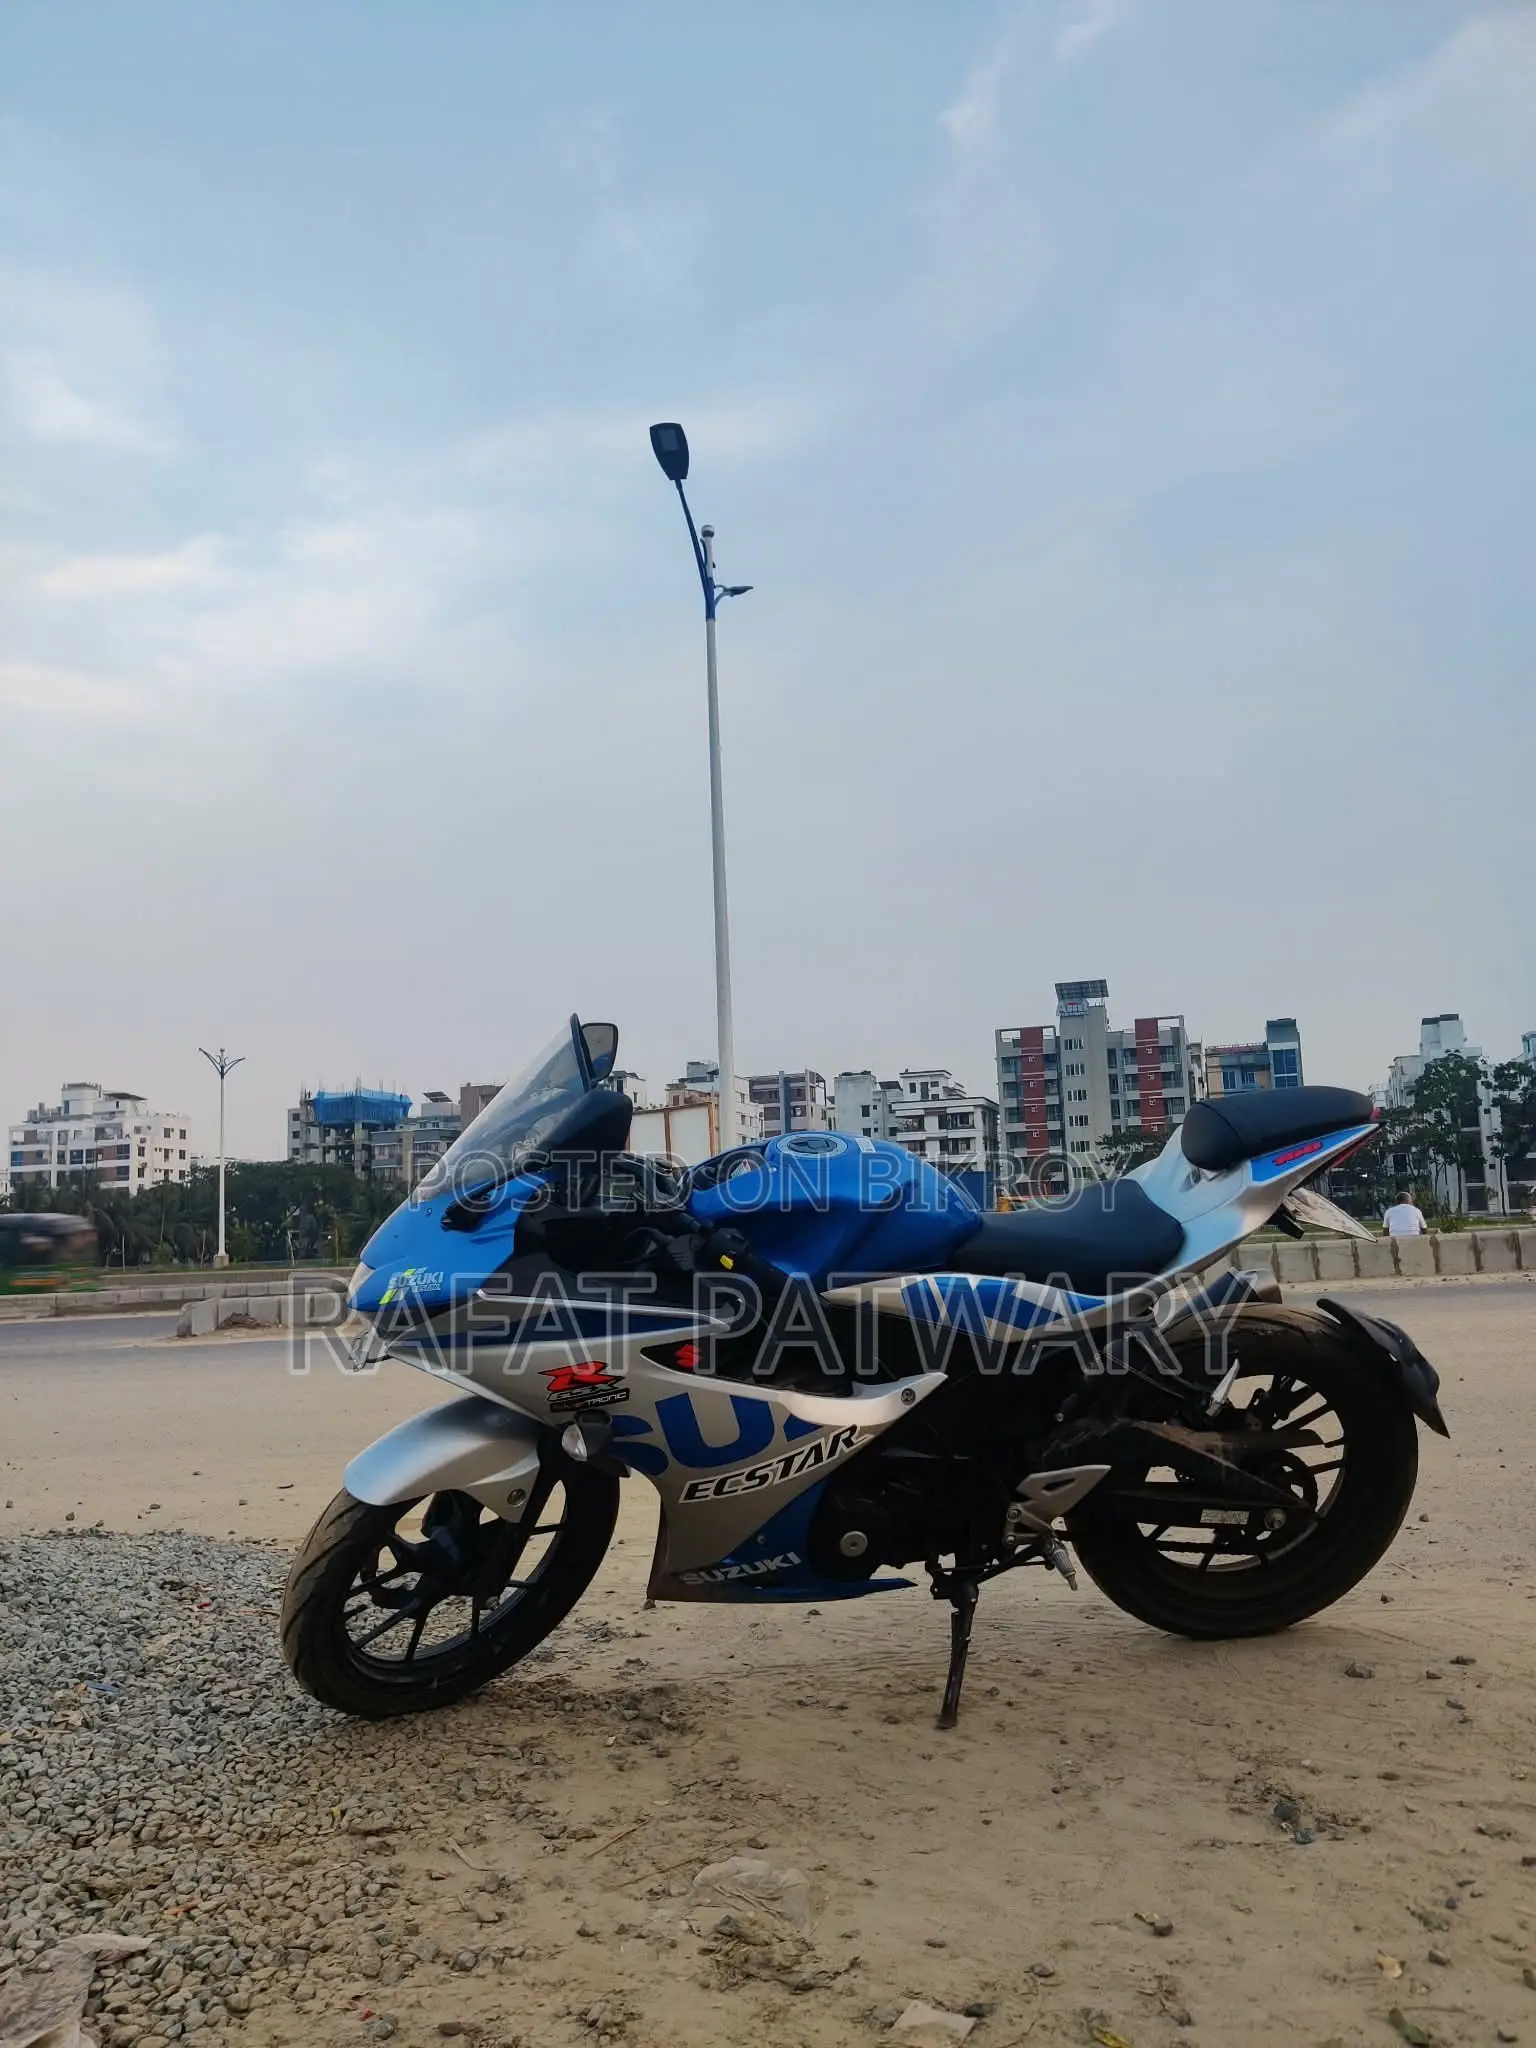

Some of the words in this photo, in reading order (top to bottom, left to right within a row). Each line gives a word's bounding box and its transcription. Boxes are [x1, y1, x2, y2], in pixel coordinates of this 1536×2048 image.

[388, 1270, 444, 1290] SUZUKI
[679, 1423, 871, 1504] ECSTAR
[680, 1551, 802, 1585] SUZUKI
